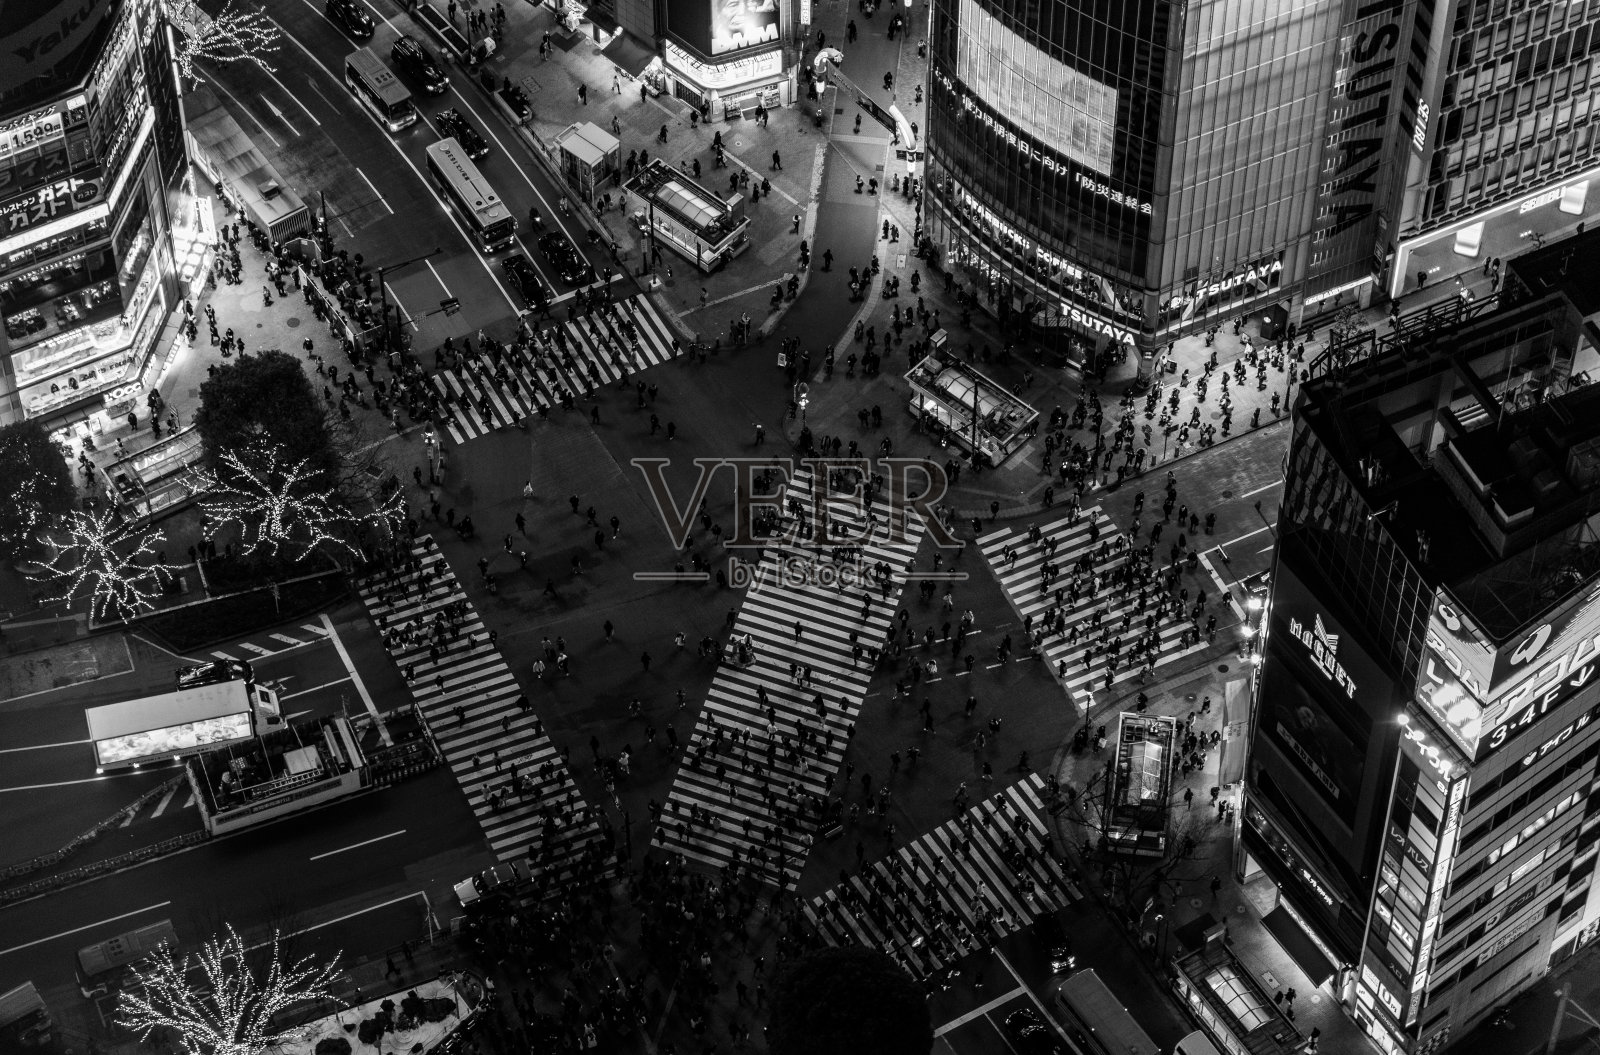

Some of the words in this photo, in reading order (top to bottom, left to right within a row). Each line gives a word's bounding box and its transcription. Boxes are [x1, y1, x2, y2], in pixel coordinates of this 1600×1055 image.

[11, 0, 100, 63] Yaku
[1413, 98, 1430, 152] SEIBU
[38, 178, 84, 203] ガスト
[9, 200, 66, 231] ガスト
[1196, 261, 1282, 299] TSUTAYA
[1060, 303, 1136, 346] TSUTAYA
[1426, 628, 1480, 698] アコム
[1541, 713, 1590, 755] アイフル
